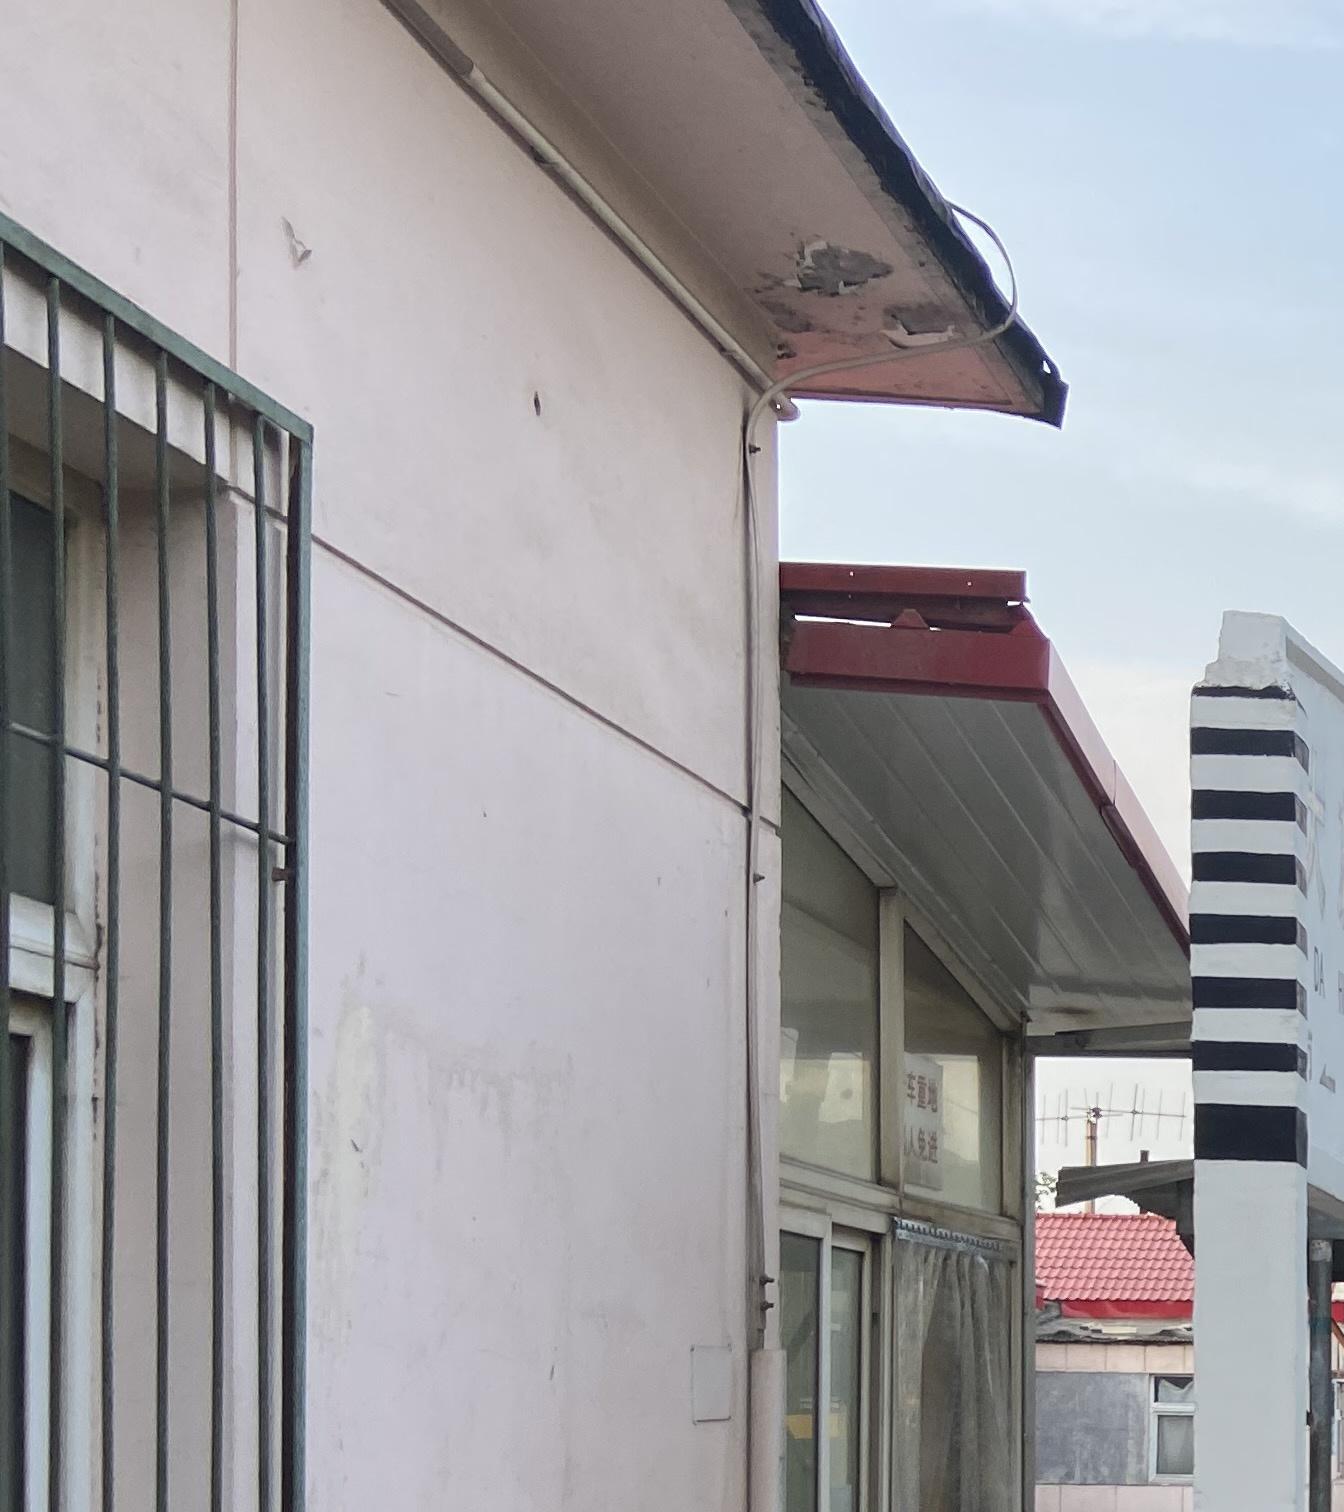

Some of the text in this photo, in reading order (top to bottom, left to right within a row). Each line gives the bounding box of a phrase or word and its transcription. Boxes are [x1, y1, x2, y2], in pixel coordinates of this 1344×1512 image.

[1313, 944, 1327, 999] DA
[903, 1070, 939, 1113] 车重地
